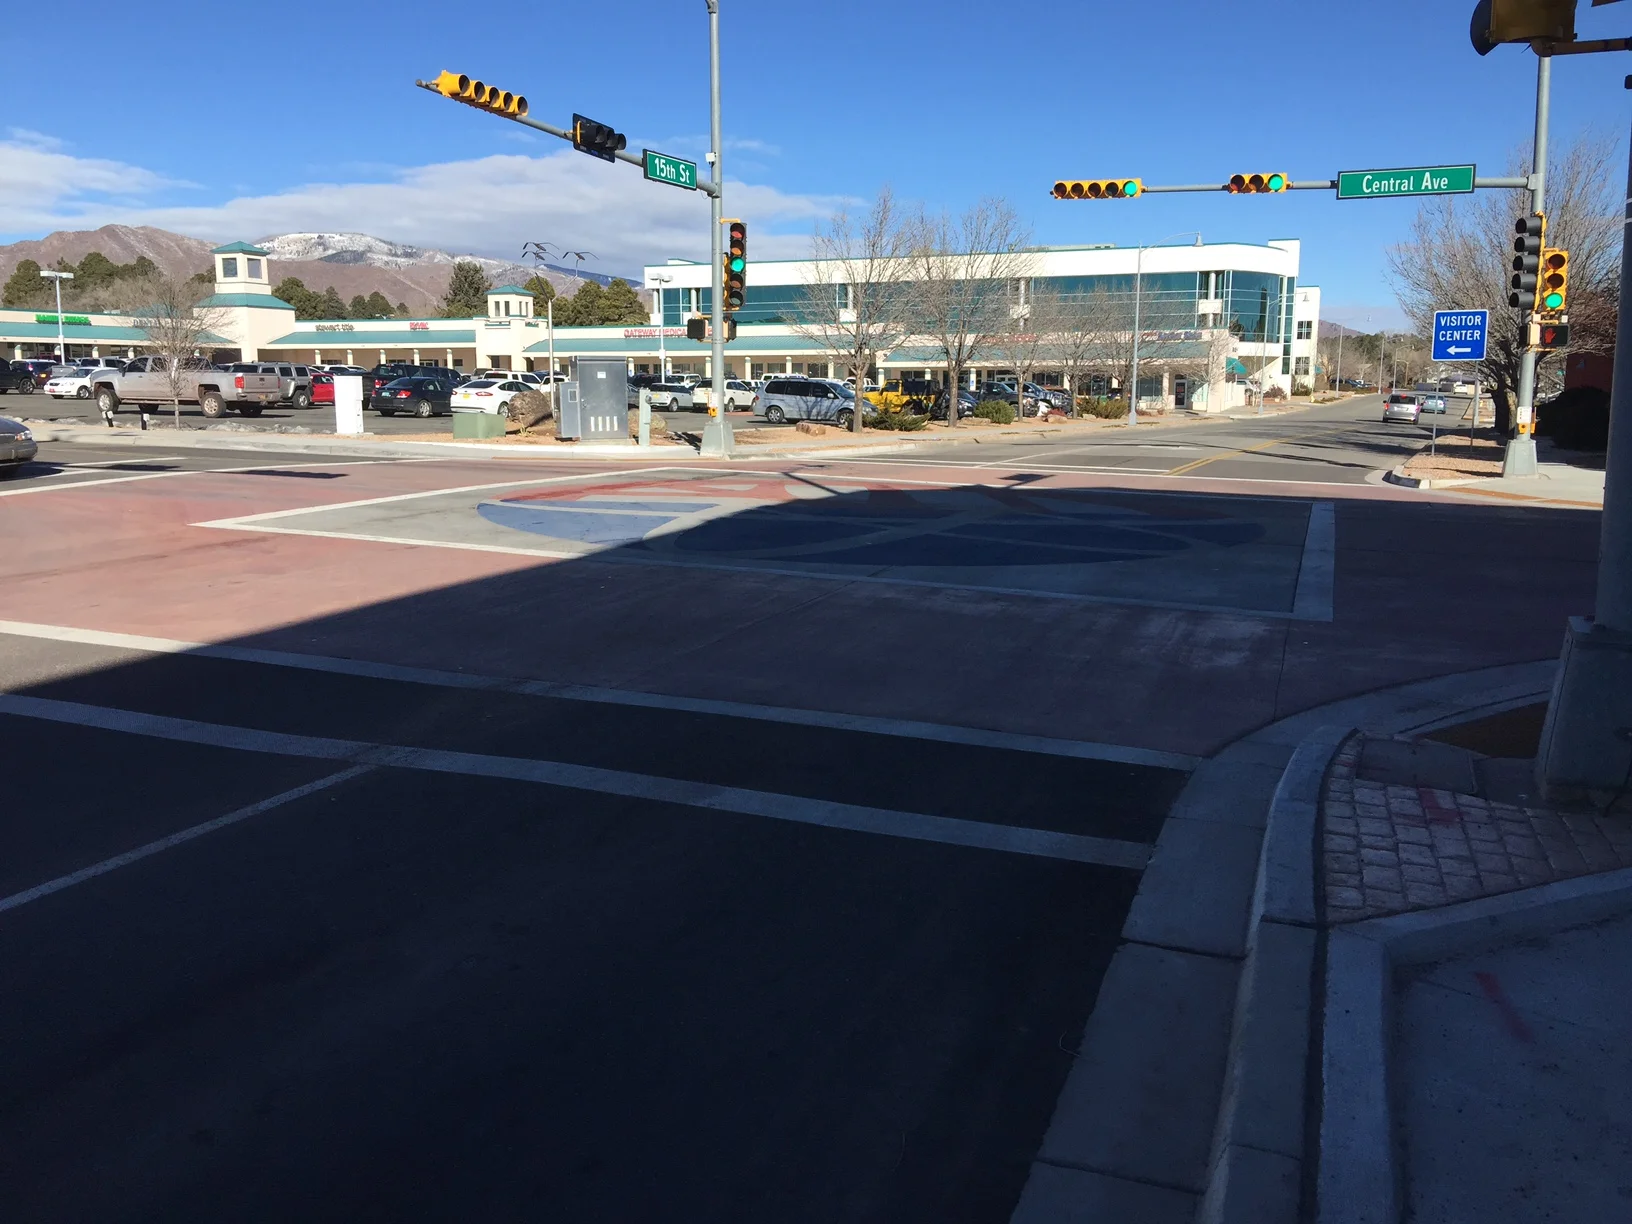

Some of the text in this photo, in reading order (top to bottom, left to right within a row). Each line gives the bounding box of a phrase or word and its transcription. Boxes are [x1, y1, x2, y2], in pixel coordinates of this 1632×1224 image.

[654, 157, 690, 184] 15th St
[1362, 171, 1449, 194] Central Ave
[1440, 315, 1482, 327] VISITOR
[624, 328, 657, 338] GATEWAY
[1439, 329, 1481, 341] CENTER
